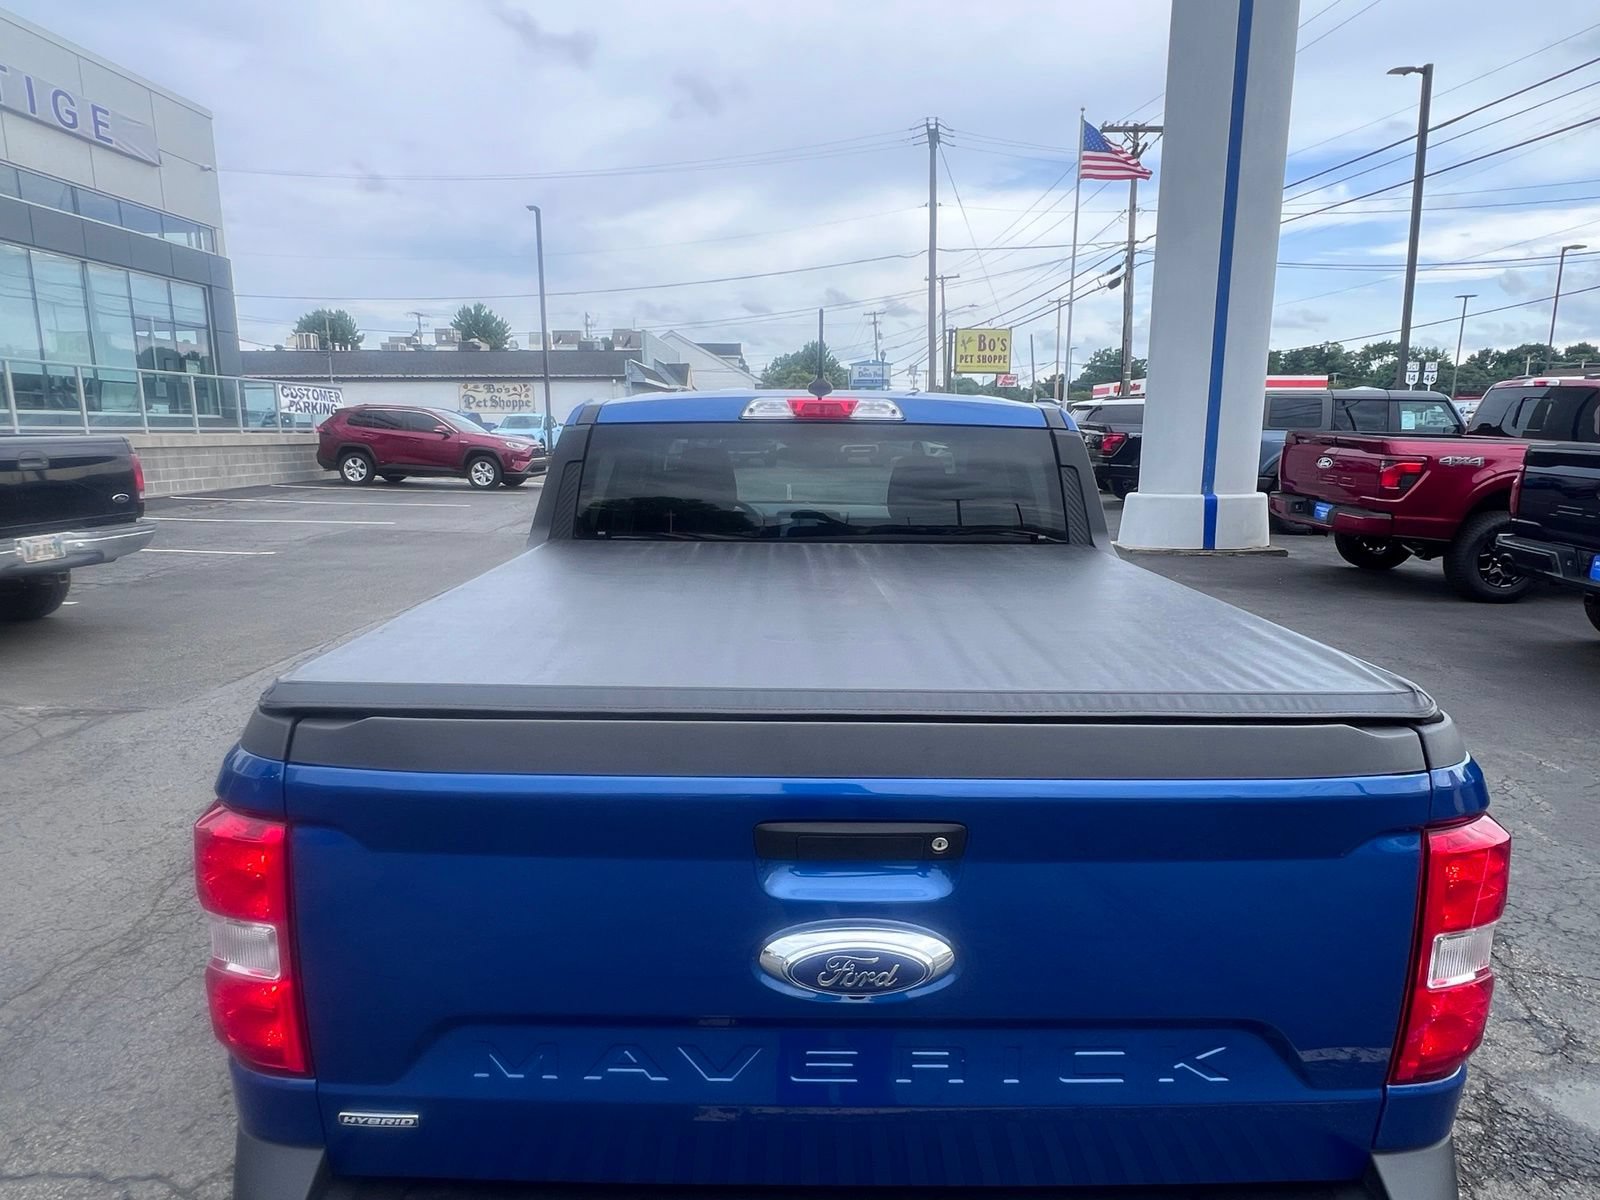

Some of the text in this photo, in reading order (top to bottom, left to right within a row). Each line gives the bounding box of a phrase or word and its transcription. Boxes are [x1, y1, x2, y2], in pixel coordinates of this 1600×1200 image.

[960, 354, 1007, 364] PET SHOPPE
[1408, 374, 1416, 382] 14
[1424, 374, 1436, 383] 46
[281, 385, 342, 403] CUSTOMER
[483, 384, 510, 393] Bo's
[288, 400, 337, 415] PARKING
[462, 394, 532, 411] Pet Shoppe
[817, 955, 900, 987] Ford
[473, 1041, 1230, 1084] MAVERICK
[343, 1116, 415, 1125] HYBRID
